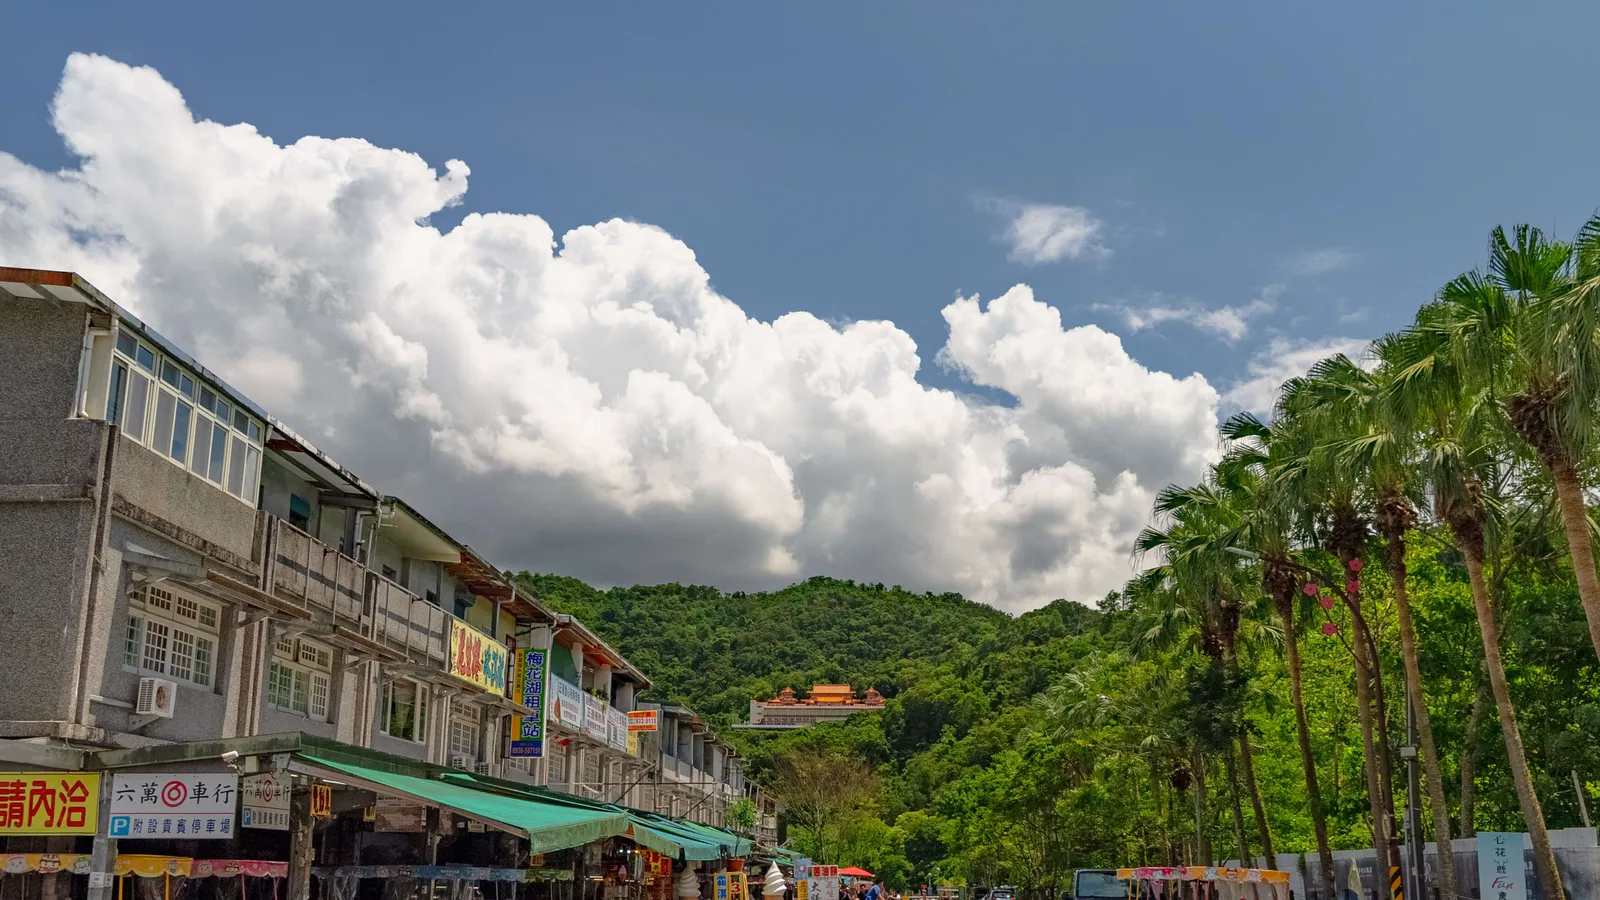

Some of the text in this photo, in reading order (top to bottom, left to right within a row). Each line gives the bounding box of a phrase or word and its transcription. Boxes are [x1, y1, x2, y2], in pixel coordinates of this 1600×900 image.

[0, 779, 89, 828] 請內洽
[132, 818, 231, 835] 附設貴賓停車場
